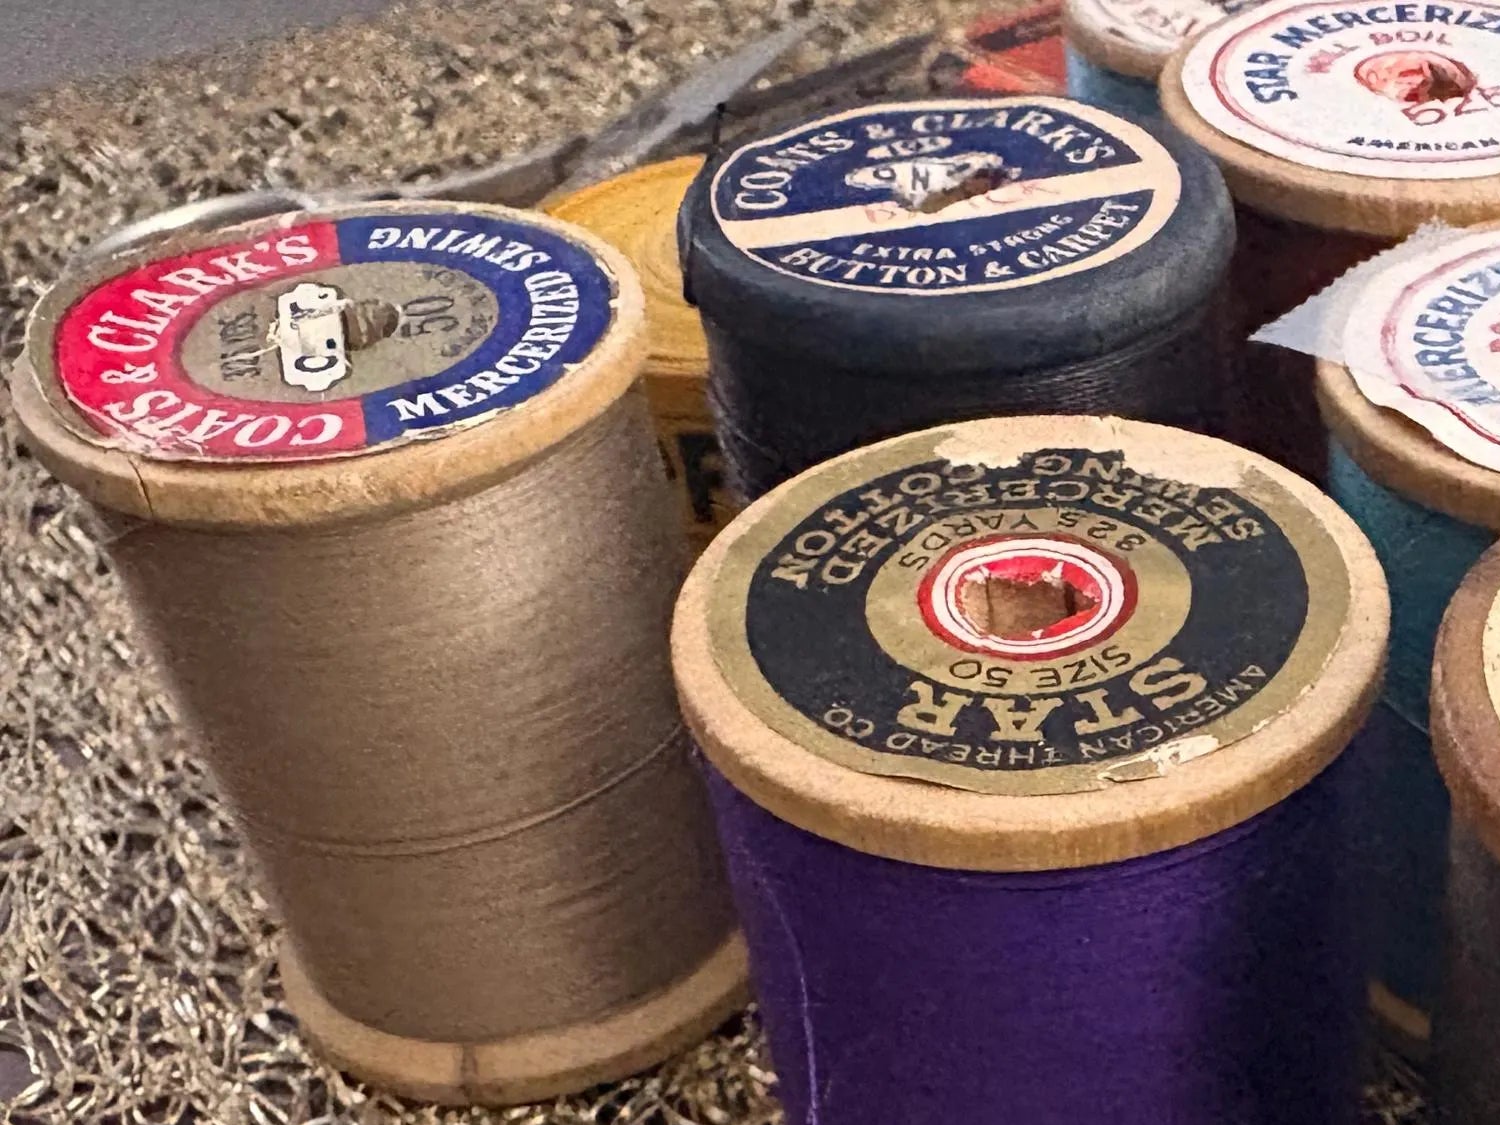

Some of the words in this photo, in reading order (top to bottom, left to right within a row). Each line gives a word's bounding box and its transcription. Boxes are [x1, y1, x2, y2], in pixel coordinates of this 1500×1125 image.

[1244, 51, 1298, 103] STAR
[735, 131, 855, 211] COATS
[368, 227, 551, 274] SEWING
[778, 247, 969, 287] BUTTON
[984, 261, 1015, 279] &
[1017, 199, 1144, 271] CARPET
[852, 242, 959, 262] EXTRA
[88, 235, 318, 352] CLARK'S
[101, 362, 158, 384] &
[387, 268, 580, 424] MERCERIZED
[103, 390, 343, 454] COATS
[770, 463, 985, 590] COTTON
[821, 479, 1223, 584] MERCERIZED
[899, 513, 1039, 571] YARDS
[1056, 512, 1147, 552] 325
[949, 659, 1013, 687] 50
[1038, 646, 1133, 688] SIZE
[897, 658, 1209, 741] STAR
[1068, 664, 1267, 763] AMERICAN
[888, 732, 1054, 767] THREAD
